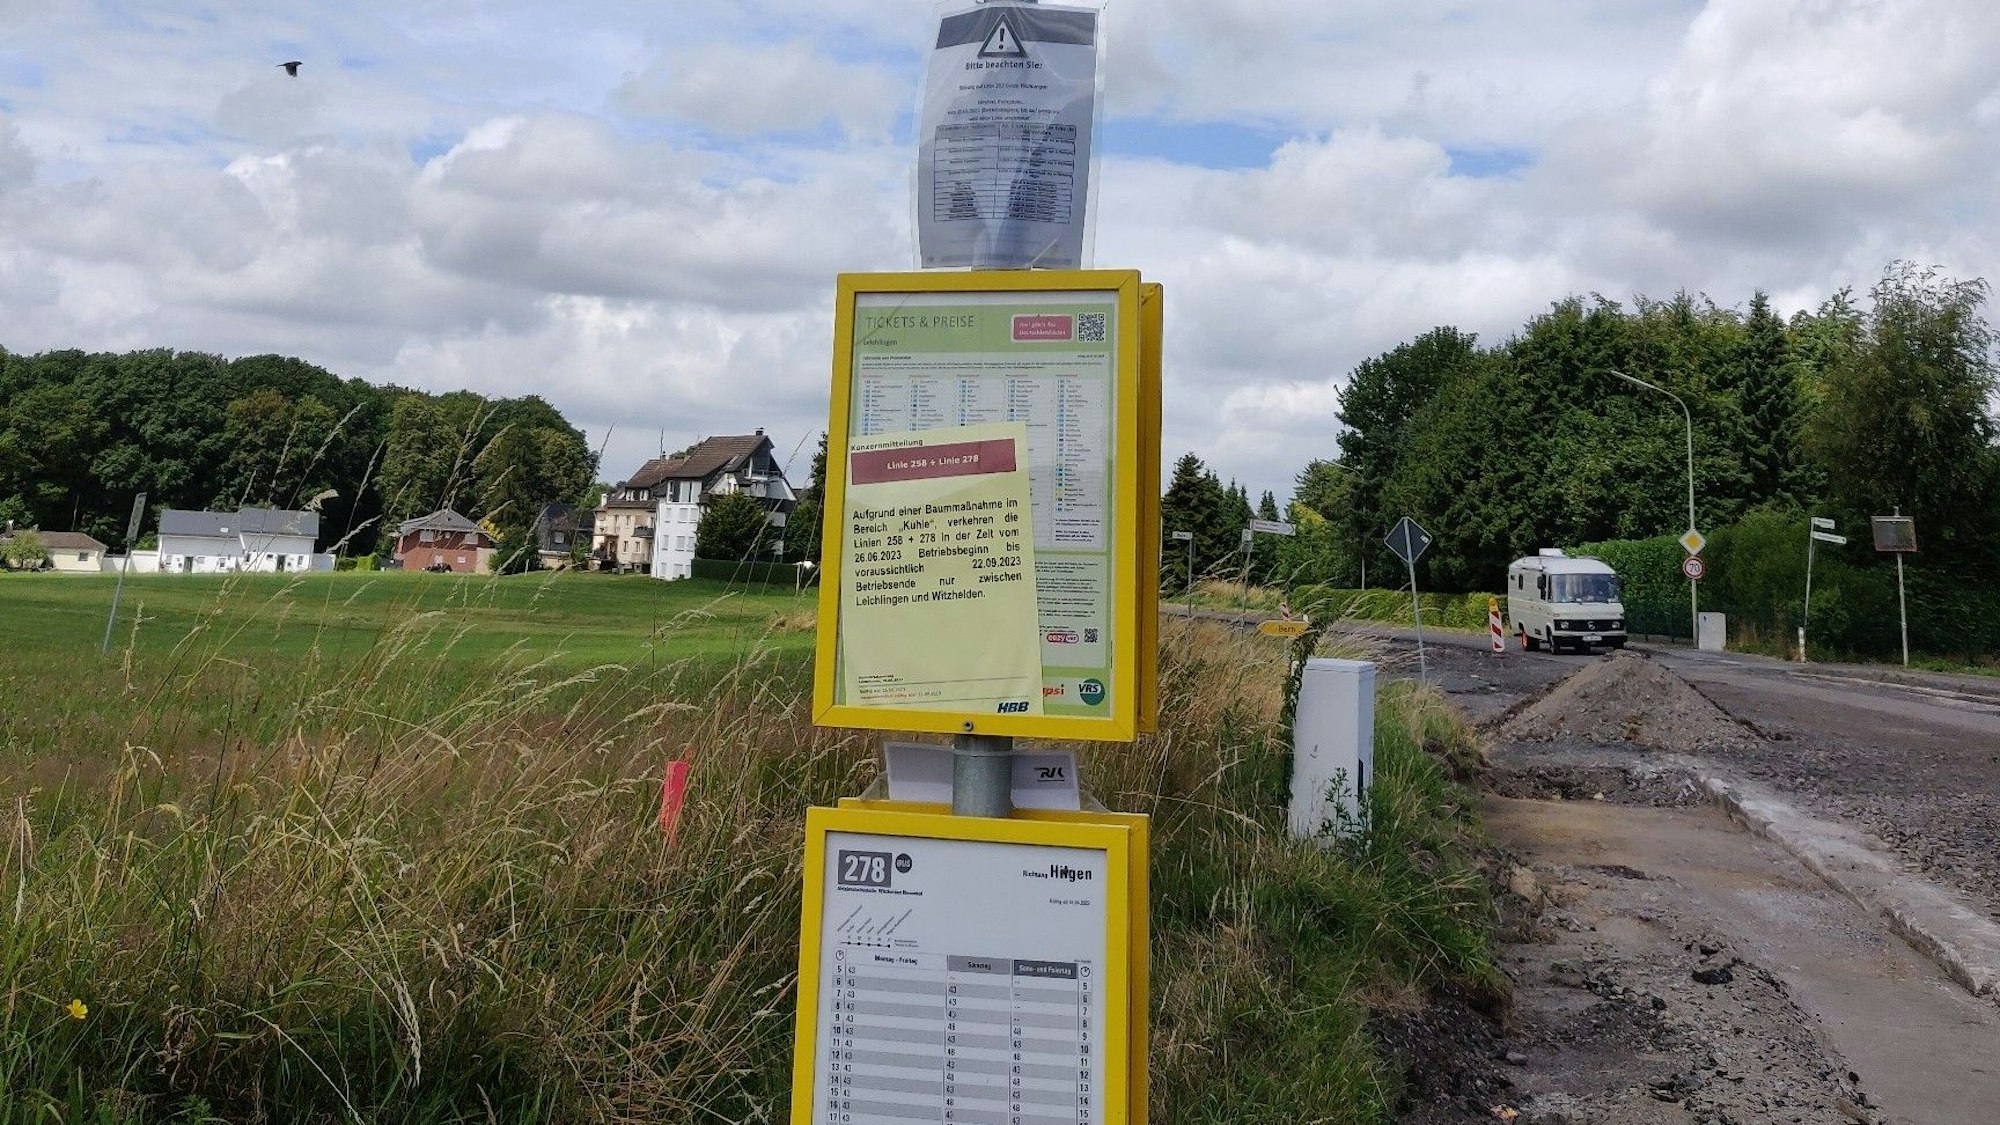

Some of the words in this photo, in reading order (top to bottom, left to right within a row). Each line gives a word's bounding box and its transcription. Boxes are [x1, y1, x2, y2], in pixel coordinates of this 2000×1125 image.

[966, 62, 983, 70] Bitte
[986, 60, 1024, 69] beachten
[866, 316, 915, 328] TICKETS
[920, 316, 928, 327] &
[933, 315, 974, 328] PREISE
[887, 462, 908, 470] Linie
[910, 460, 927, 468] 258
[939, 456, 960, 465] Linie
[962, 454, 978, 463] 278
[852, 508, 894, 520] Aufgrund
[899, 506, 922, 516] einer
[926, 500, 1002, 514] Baummaßnahme
[1006, 498, 1018, 508] im
[854, 523, 888, 534] Bereich
[948, 516, 994, 527] verkehren
[1004, 512, 1018, 522] die
[854, 538, 882, 548] Linien
[887, 536, 903, 546] 258
[920, 534, 936, 543] 278
[956, 530, 970, 540] der
[976, 529, 994, 539] Zeit
[999, 528, 1019, 537] vom
[854, 550, 902, 562] 26.06.2023
[918, 546, 989, 558] Betriebsbeginn
[1006, 542, 1020, 552] bis
[855, 564, 924, 576] voraussichtlich
[972, 556, 1022, 568] 22.09.2023
[856, 579, 916, 592] Betriebsende
[940, 577, 955, 586] nur
[978, 572, 1022, 583] zwischen
[856, 594, 909, 606] Leichlingen
[912, 591, 928, 602] und
[932, 588, 986, 600] Witzhelden.
[1078, 684, 1098, 692] VRS
[998, 702, 1029, 713] HBB
[844, 855, 885, 882] 278
[1082, 1032, 1088, 1040] 9
[1080, 1046, 1088, 1054] 10
[1080, 1070, 1088, 1079] 12
[831, 1076, 838, 1084] 14
[1080, 1096, 1088, 1104] 14
[1080, 1084, 1088, 1092] 13
[831, 1088, 838, 1096] 15
[1080, 1110, 1088, 1118] 15
